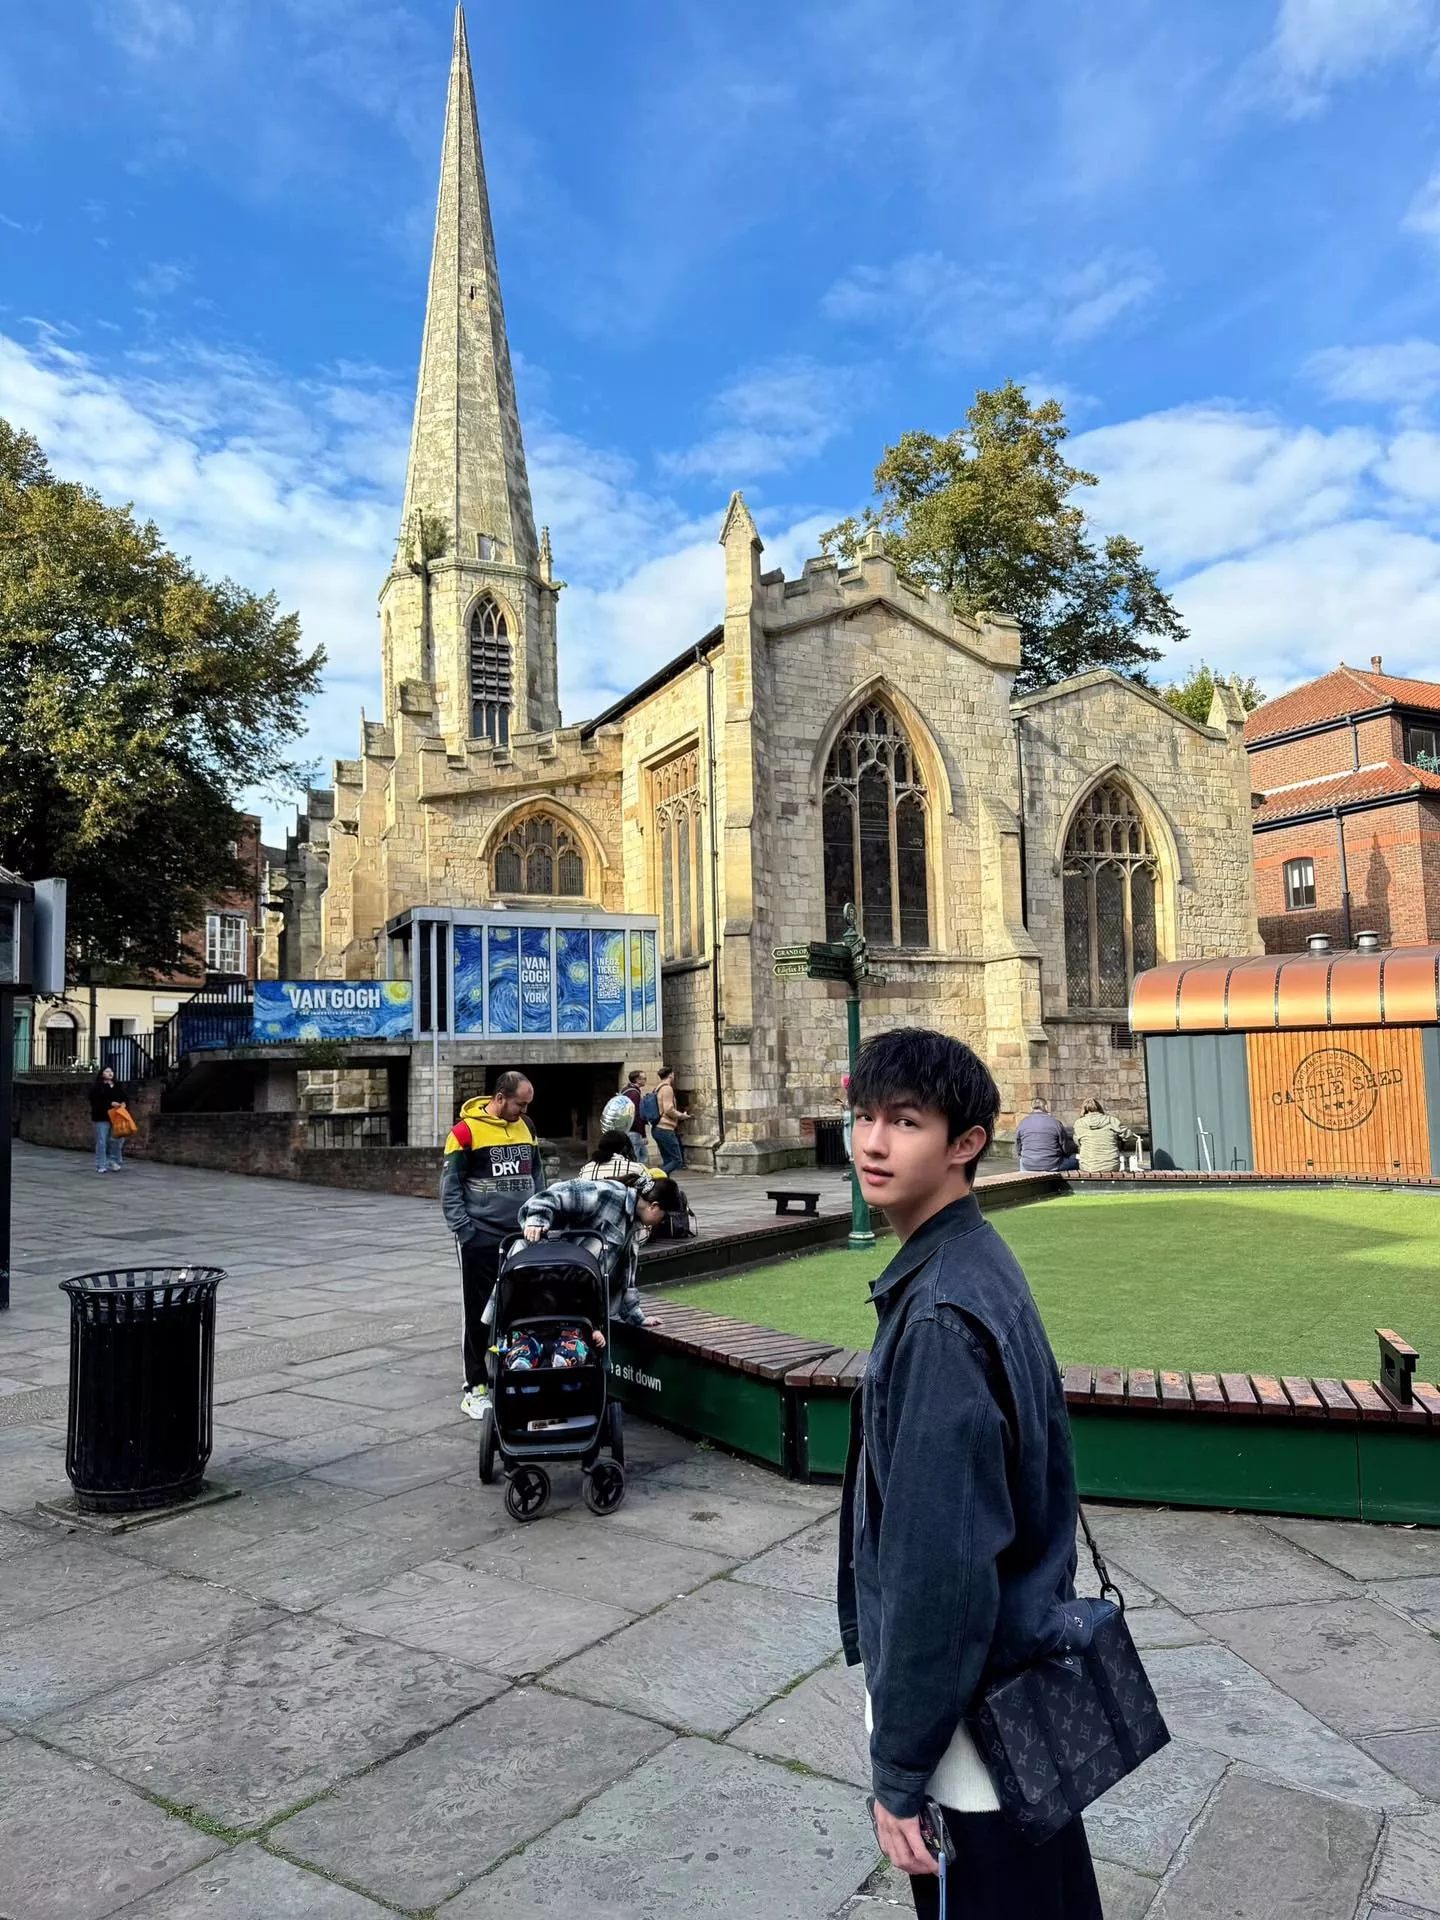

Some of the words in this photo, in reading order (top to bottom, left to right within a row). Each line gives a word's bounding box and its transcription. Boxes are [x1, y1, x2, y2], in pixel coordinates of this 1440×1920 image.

[776, 949, 799, 957] GRAND
[525, 956, 547, 970] VAN
[521, 970, 550, 983] GOGH
[289, 988, 327, 1009] VAN
[331, 988, 380, 1009] GOGH
[524, 991, 548, 1003] YORK
[1316, 1066, 1344, 1081] THE
[1271, 1080, 1345, 1106] CATTLE
[1352, 1068, 1404, 1092] SHED
[491, 1161, 520, 1177] DRY
[615, 1364, 621, 1377] a
[622, 1365, 634, 1382] sit
[635, 1369, 662, 1392] down
